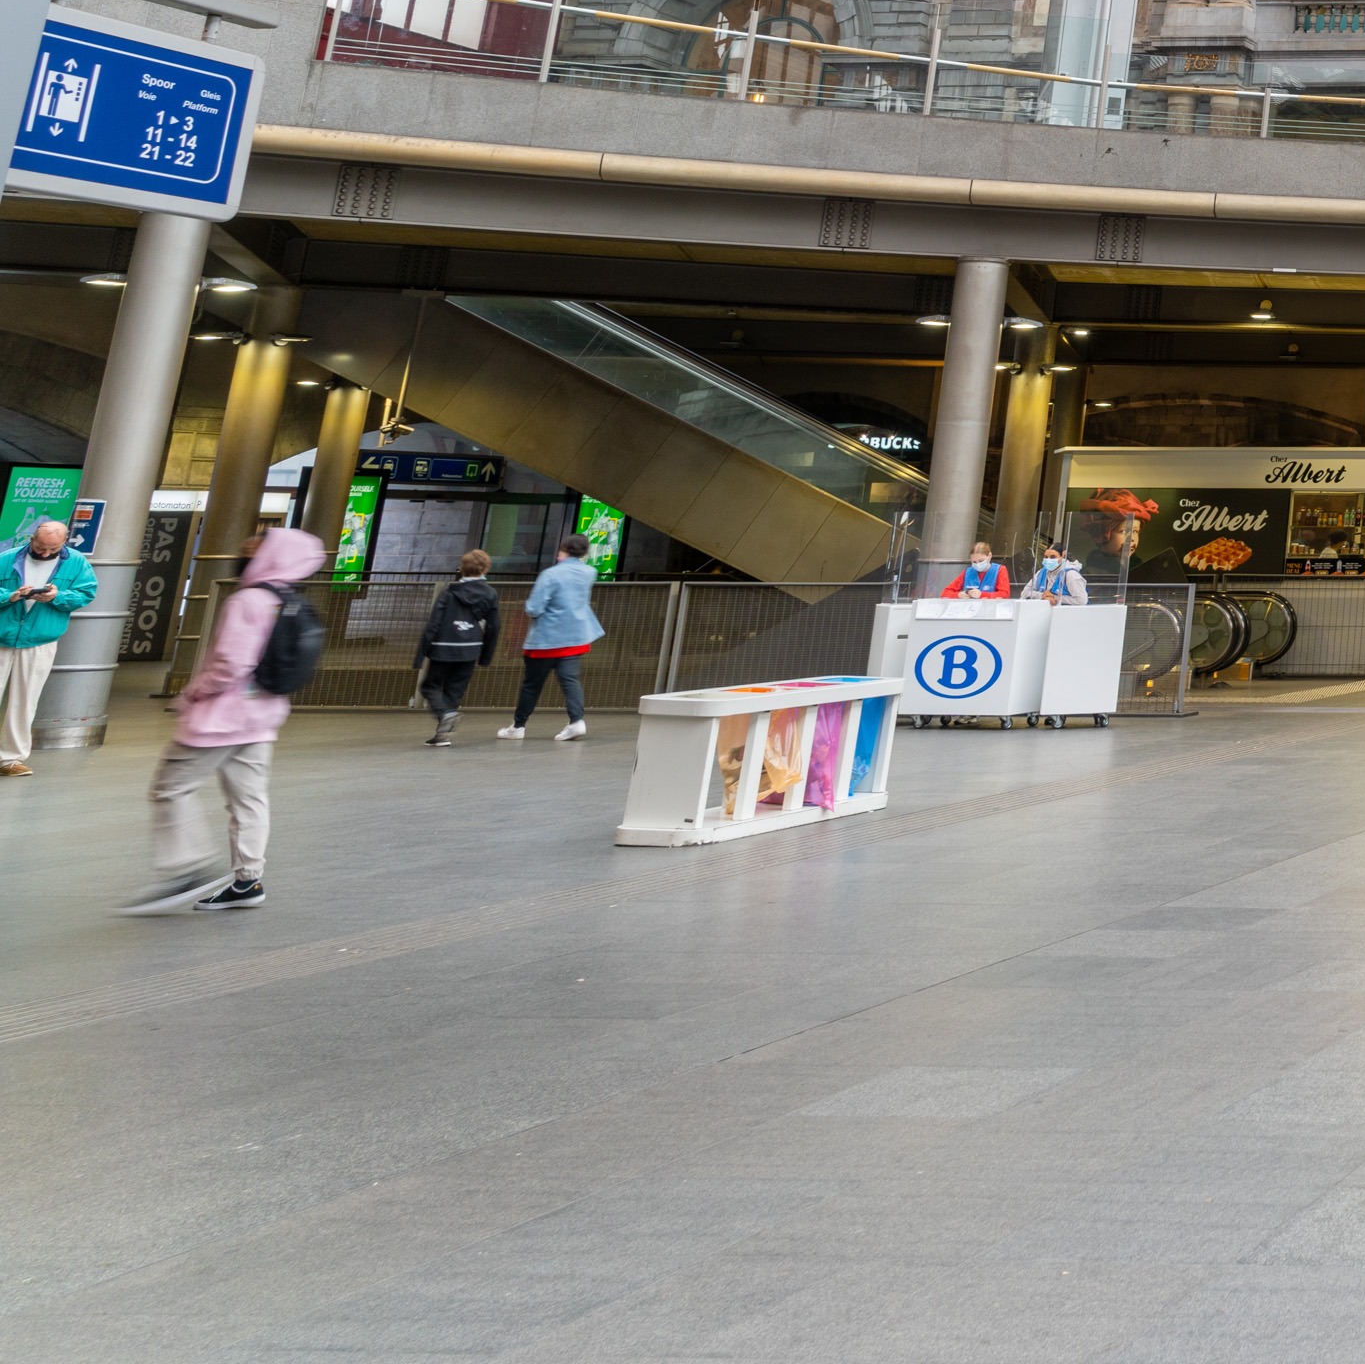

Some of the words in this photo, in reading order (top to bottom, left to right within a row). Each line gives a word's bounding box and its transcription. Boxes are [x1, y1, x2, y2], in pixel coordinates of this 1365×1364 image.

[142, 73, 176, 89] Spoor
[138, 90, 157, 101] Voie
[200, 89, 221, 101] Gleis
[182, 100, 218, 115] Platform
[156, 110, 165, 125] 1
[183, 116, 194, 131] 3
[145, 126, 163, 143] 11
[179, 133, 198, 150] 14
[139, 143, 160, 160] 21
[173, 150, 196, 167] 22
[1270, 455, 1288, 463] Chez
[1265, 461, 1346, 484] Albert
[15, 477, 66, 488] REFRESH
[13, 488, 72, 499] YOURSELF.
[150, 501, 191, 509] otomaton
[1179, 498, 1200, 507] Chez
[1172, 505, 1269, 532] Albert
[937, 645, 978, 690] B
